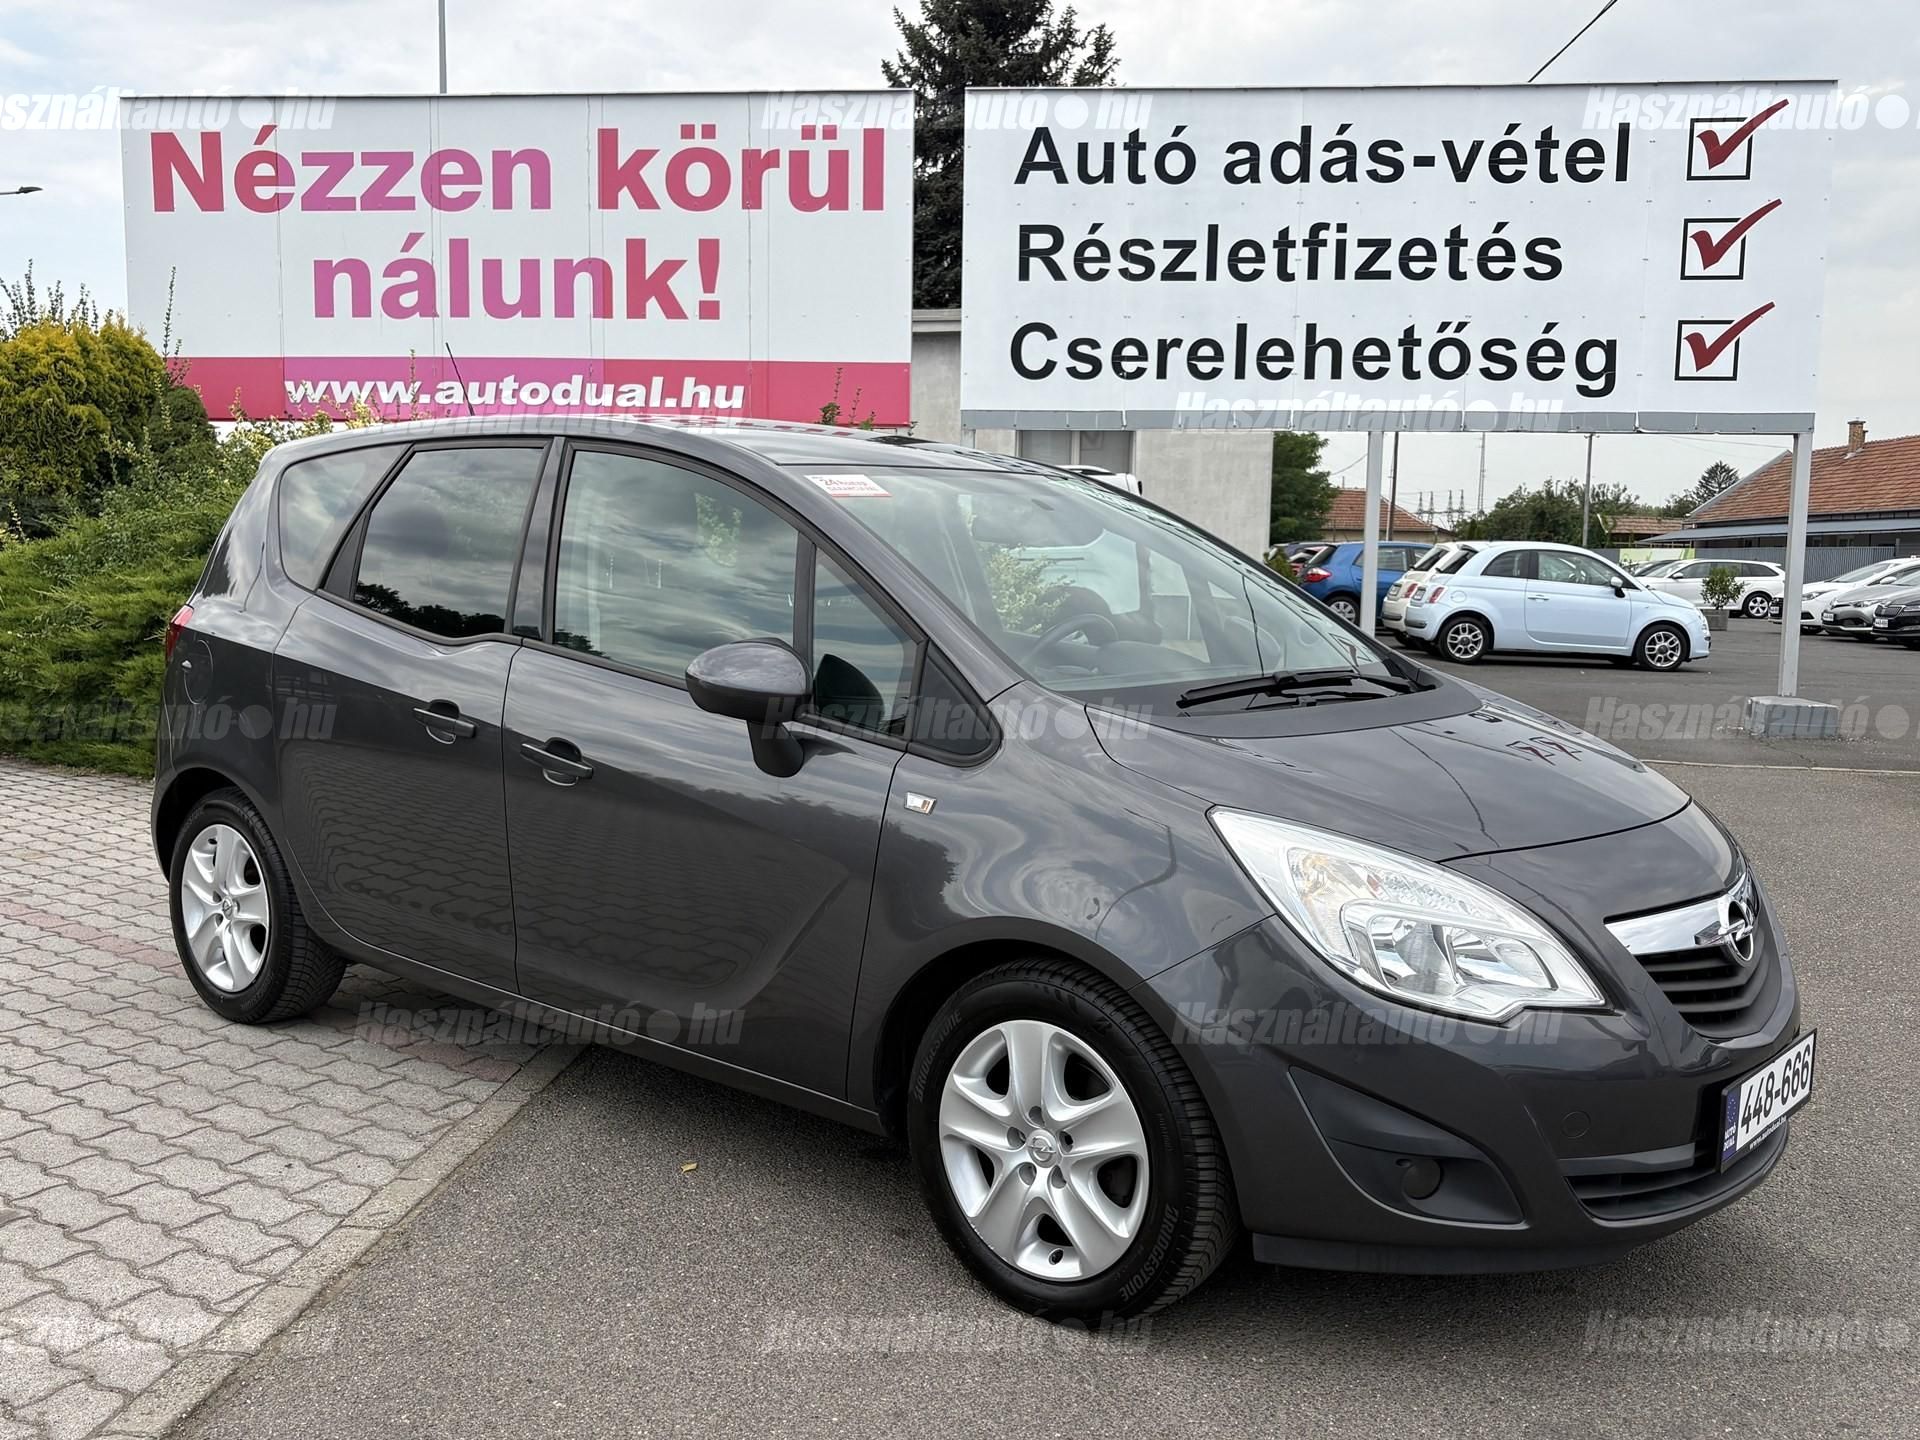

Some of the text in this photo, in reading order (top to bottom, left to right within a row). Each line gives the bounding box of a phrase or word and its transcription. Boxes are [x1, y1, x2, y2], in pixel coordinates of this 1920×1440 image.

[152, 124, 884, 212] Nézzen körül
[1015, 122, 1631, 185] Autó adás-vétel
[314, 233, 720, 319] nálunk!
[1019, 220, 1563, 283] Részletfizetés
[284, 375, 746, 410] www.autodual.hu
[1011, 320, 1617, 398] Cserelehetőség
[1739, 1043, 1812, 1134] 448-666
[1118, 1202, 1180, 1303] BRIDGESTONE
